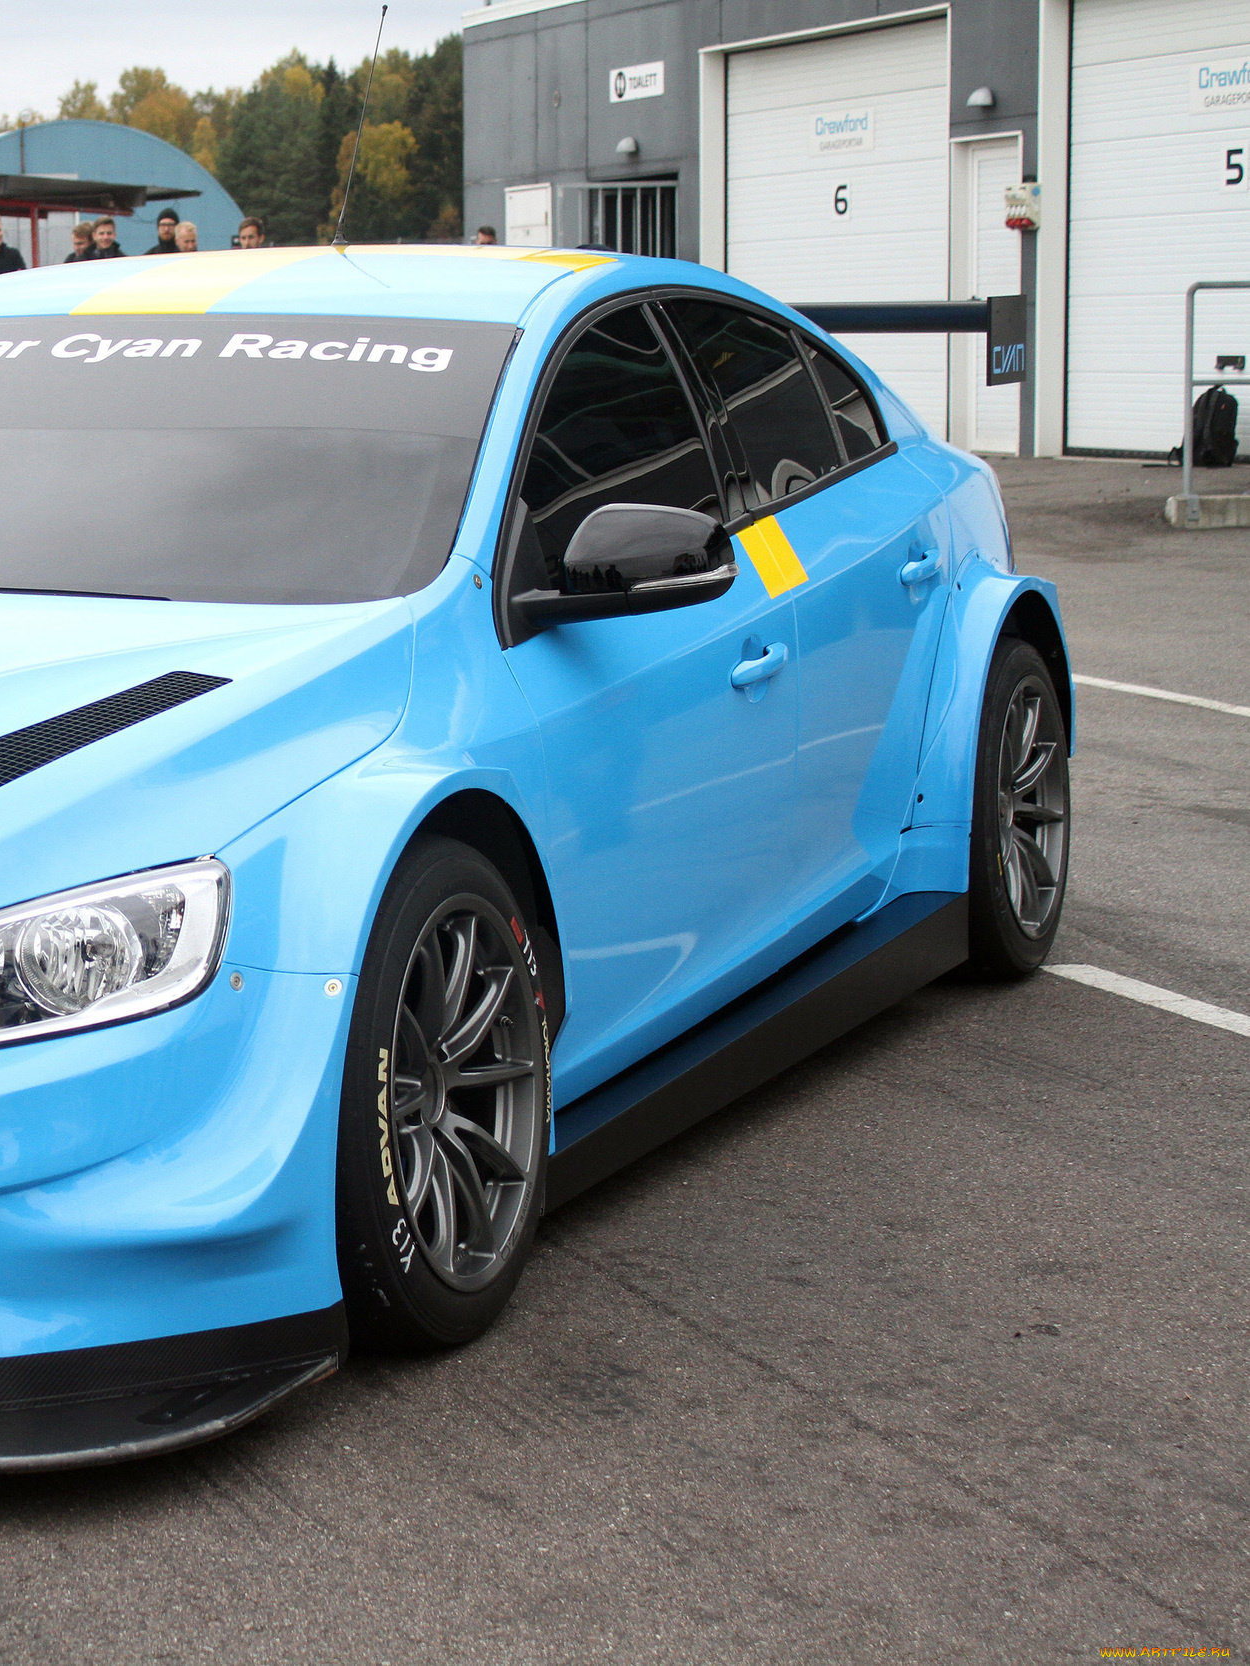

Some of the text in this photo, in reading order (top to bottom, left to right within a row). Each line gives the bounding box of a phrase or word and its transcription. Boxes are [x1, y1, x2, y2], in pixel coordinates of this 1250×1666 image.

[1199, 61, 1250, 89] Crawf
[815, 112, 868, 136] Crawford
[1225, 148, 1243, 186] 5
[834, 184, 848, 216] 6
[51, 333, 203, 363] Cyan
[218, 333, 454, 372] Racing
[377, 1047, 400, 1207] ADVAN
